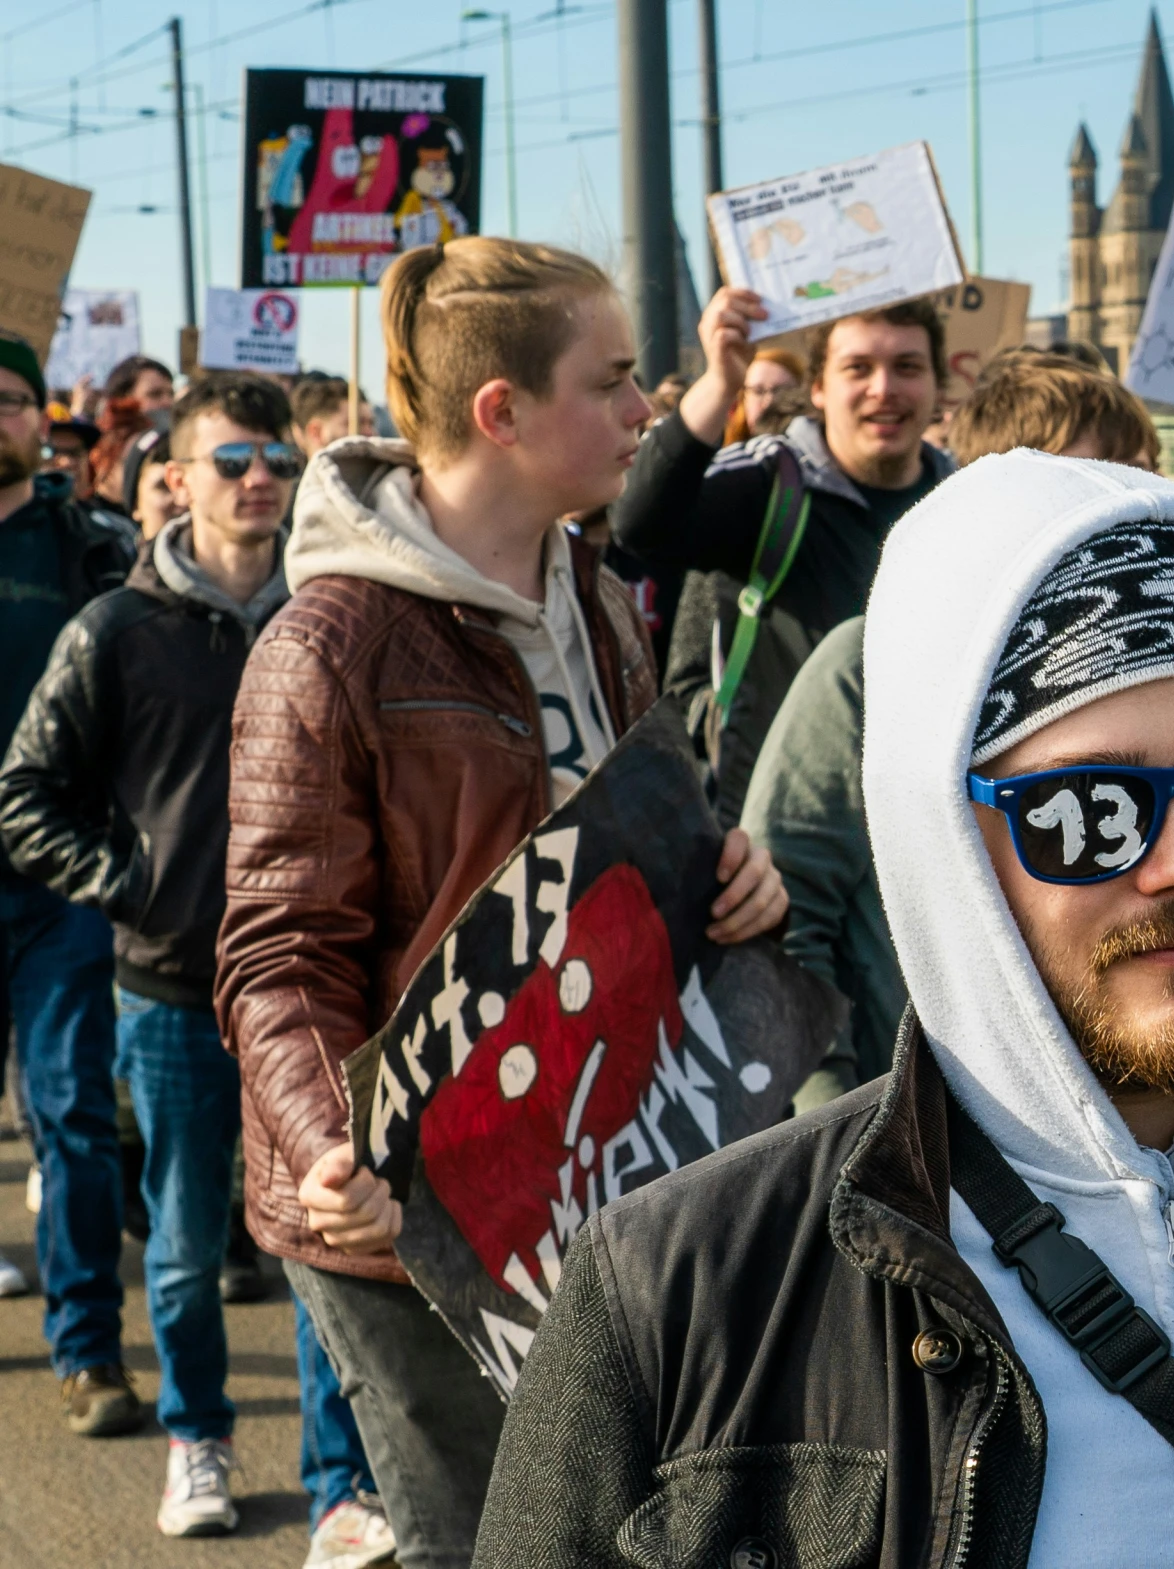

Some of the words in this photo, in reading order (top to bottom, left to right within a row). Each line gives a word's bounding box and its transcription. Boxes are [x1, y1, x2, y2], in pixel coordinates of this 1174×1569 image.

[304, 76, 354, 110] NEIN
[357, 79, 446, 113] PATRICK
[312, 212, 396, 244] ARTIKEL
[262, 253, 298, 285] IST
[303, 253, 363, 284] KEINE
[1026, 783, 1143, 868] 13
